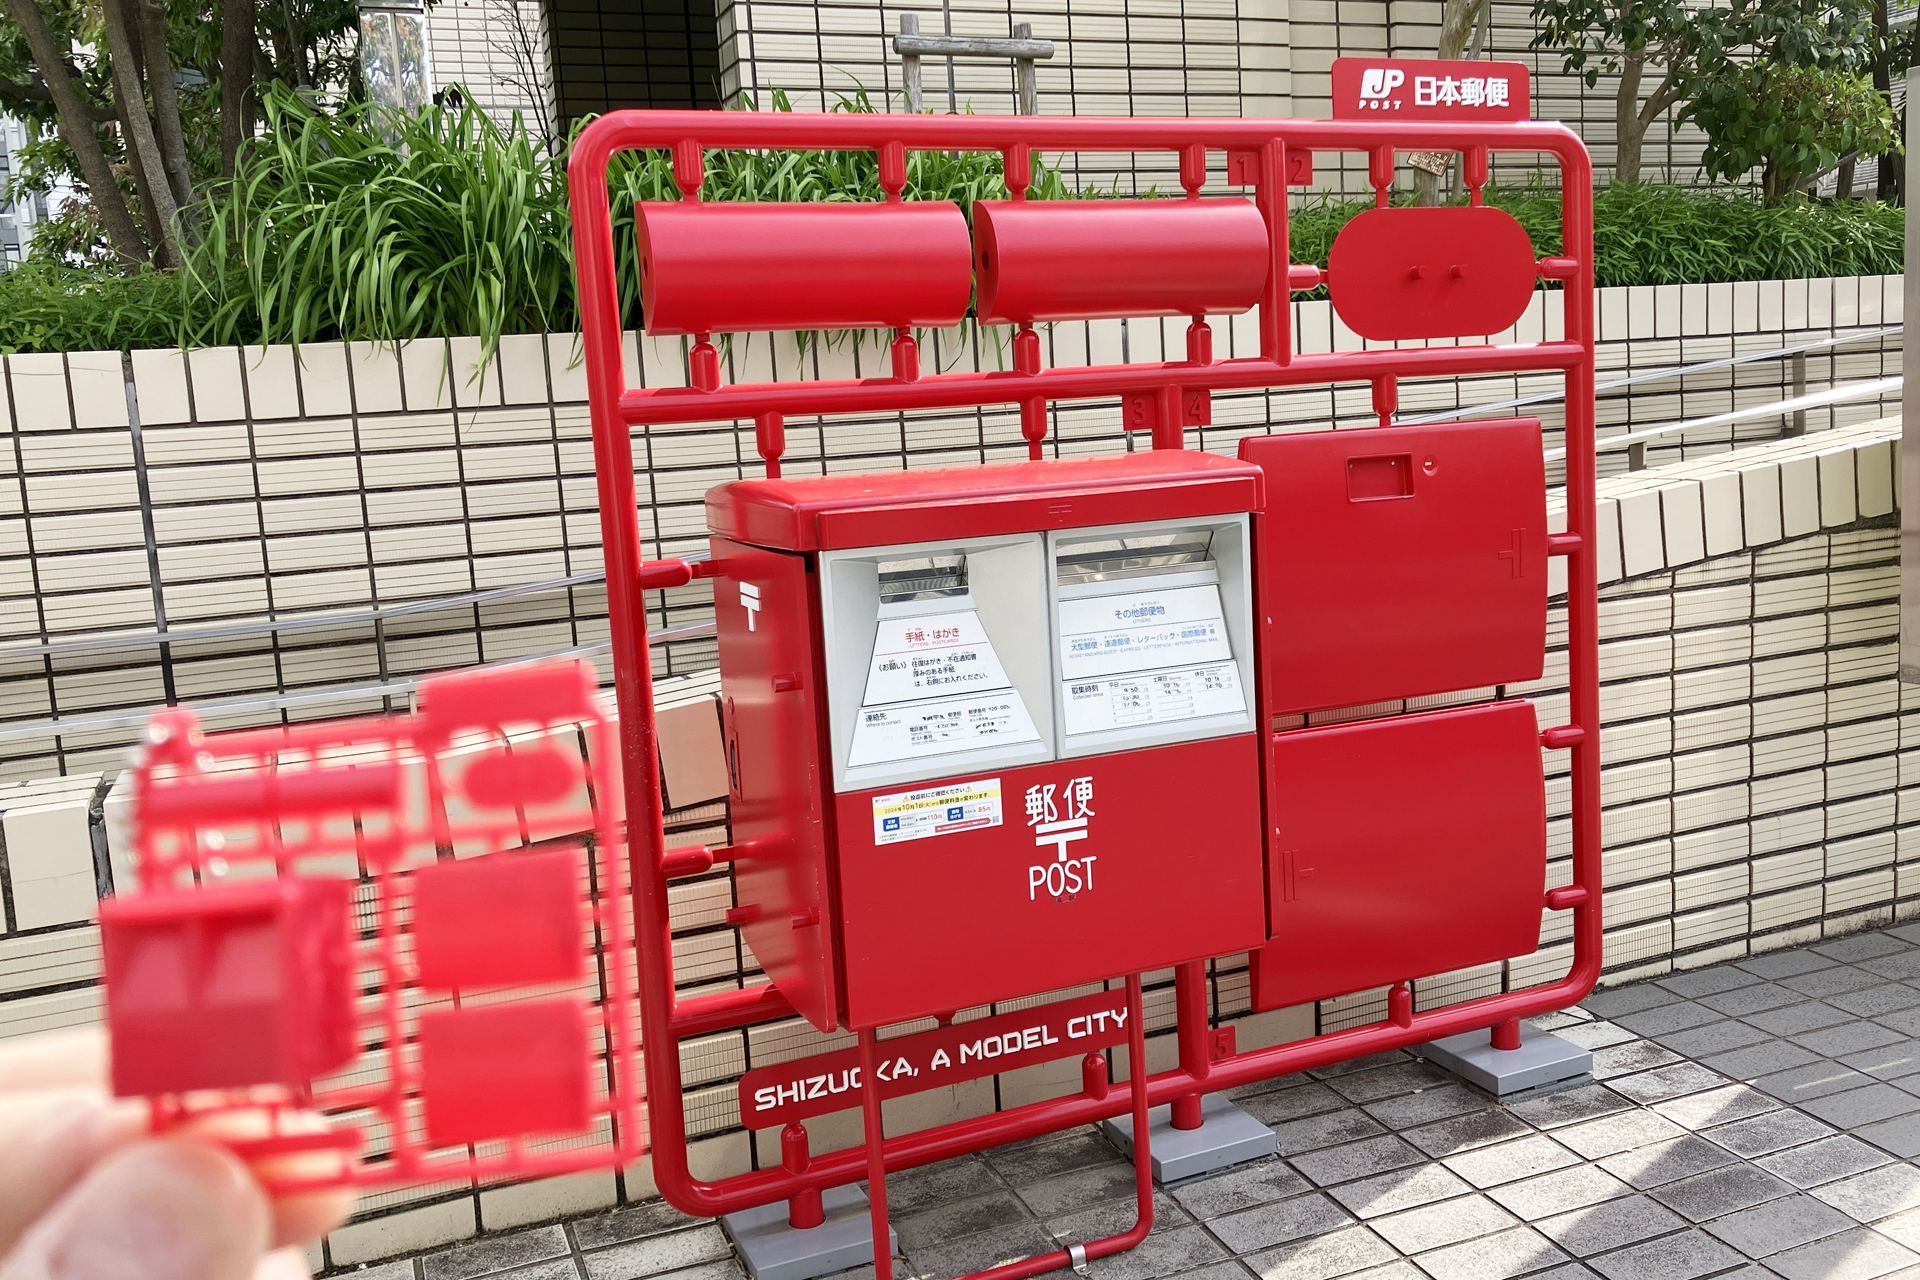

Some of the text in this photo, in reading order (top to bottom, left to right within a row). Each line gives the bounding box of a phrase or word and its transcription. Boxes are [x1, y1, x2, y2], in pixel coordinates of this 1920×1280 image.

[1358, 100, 1402, 110] POST
[1415, 76, 1509, 107] 日本郵便
[1237, 157, 1248, 183] 1
[1291, 156, 1305, 183] 2
[1131, 398, 1146, 425] 3
[1189, 394, 1206, 421] 4
[1115, 606, 1165, 620] その他郵便物
[905, 627, 960, 643] 手紙・はがき
[1025, 776, 1096, 826] 郵便
[1029, 856, 1097, 901] POST
[930, 1048, 951, 1071] A
[959, 1025, 1059, 1064] MODEL
[1067, 1007, 1128, 1039] CITY
[1214, 1033, 1229, 1060] 5
